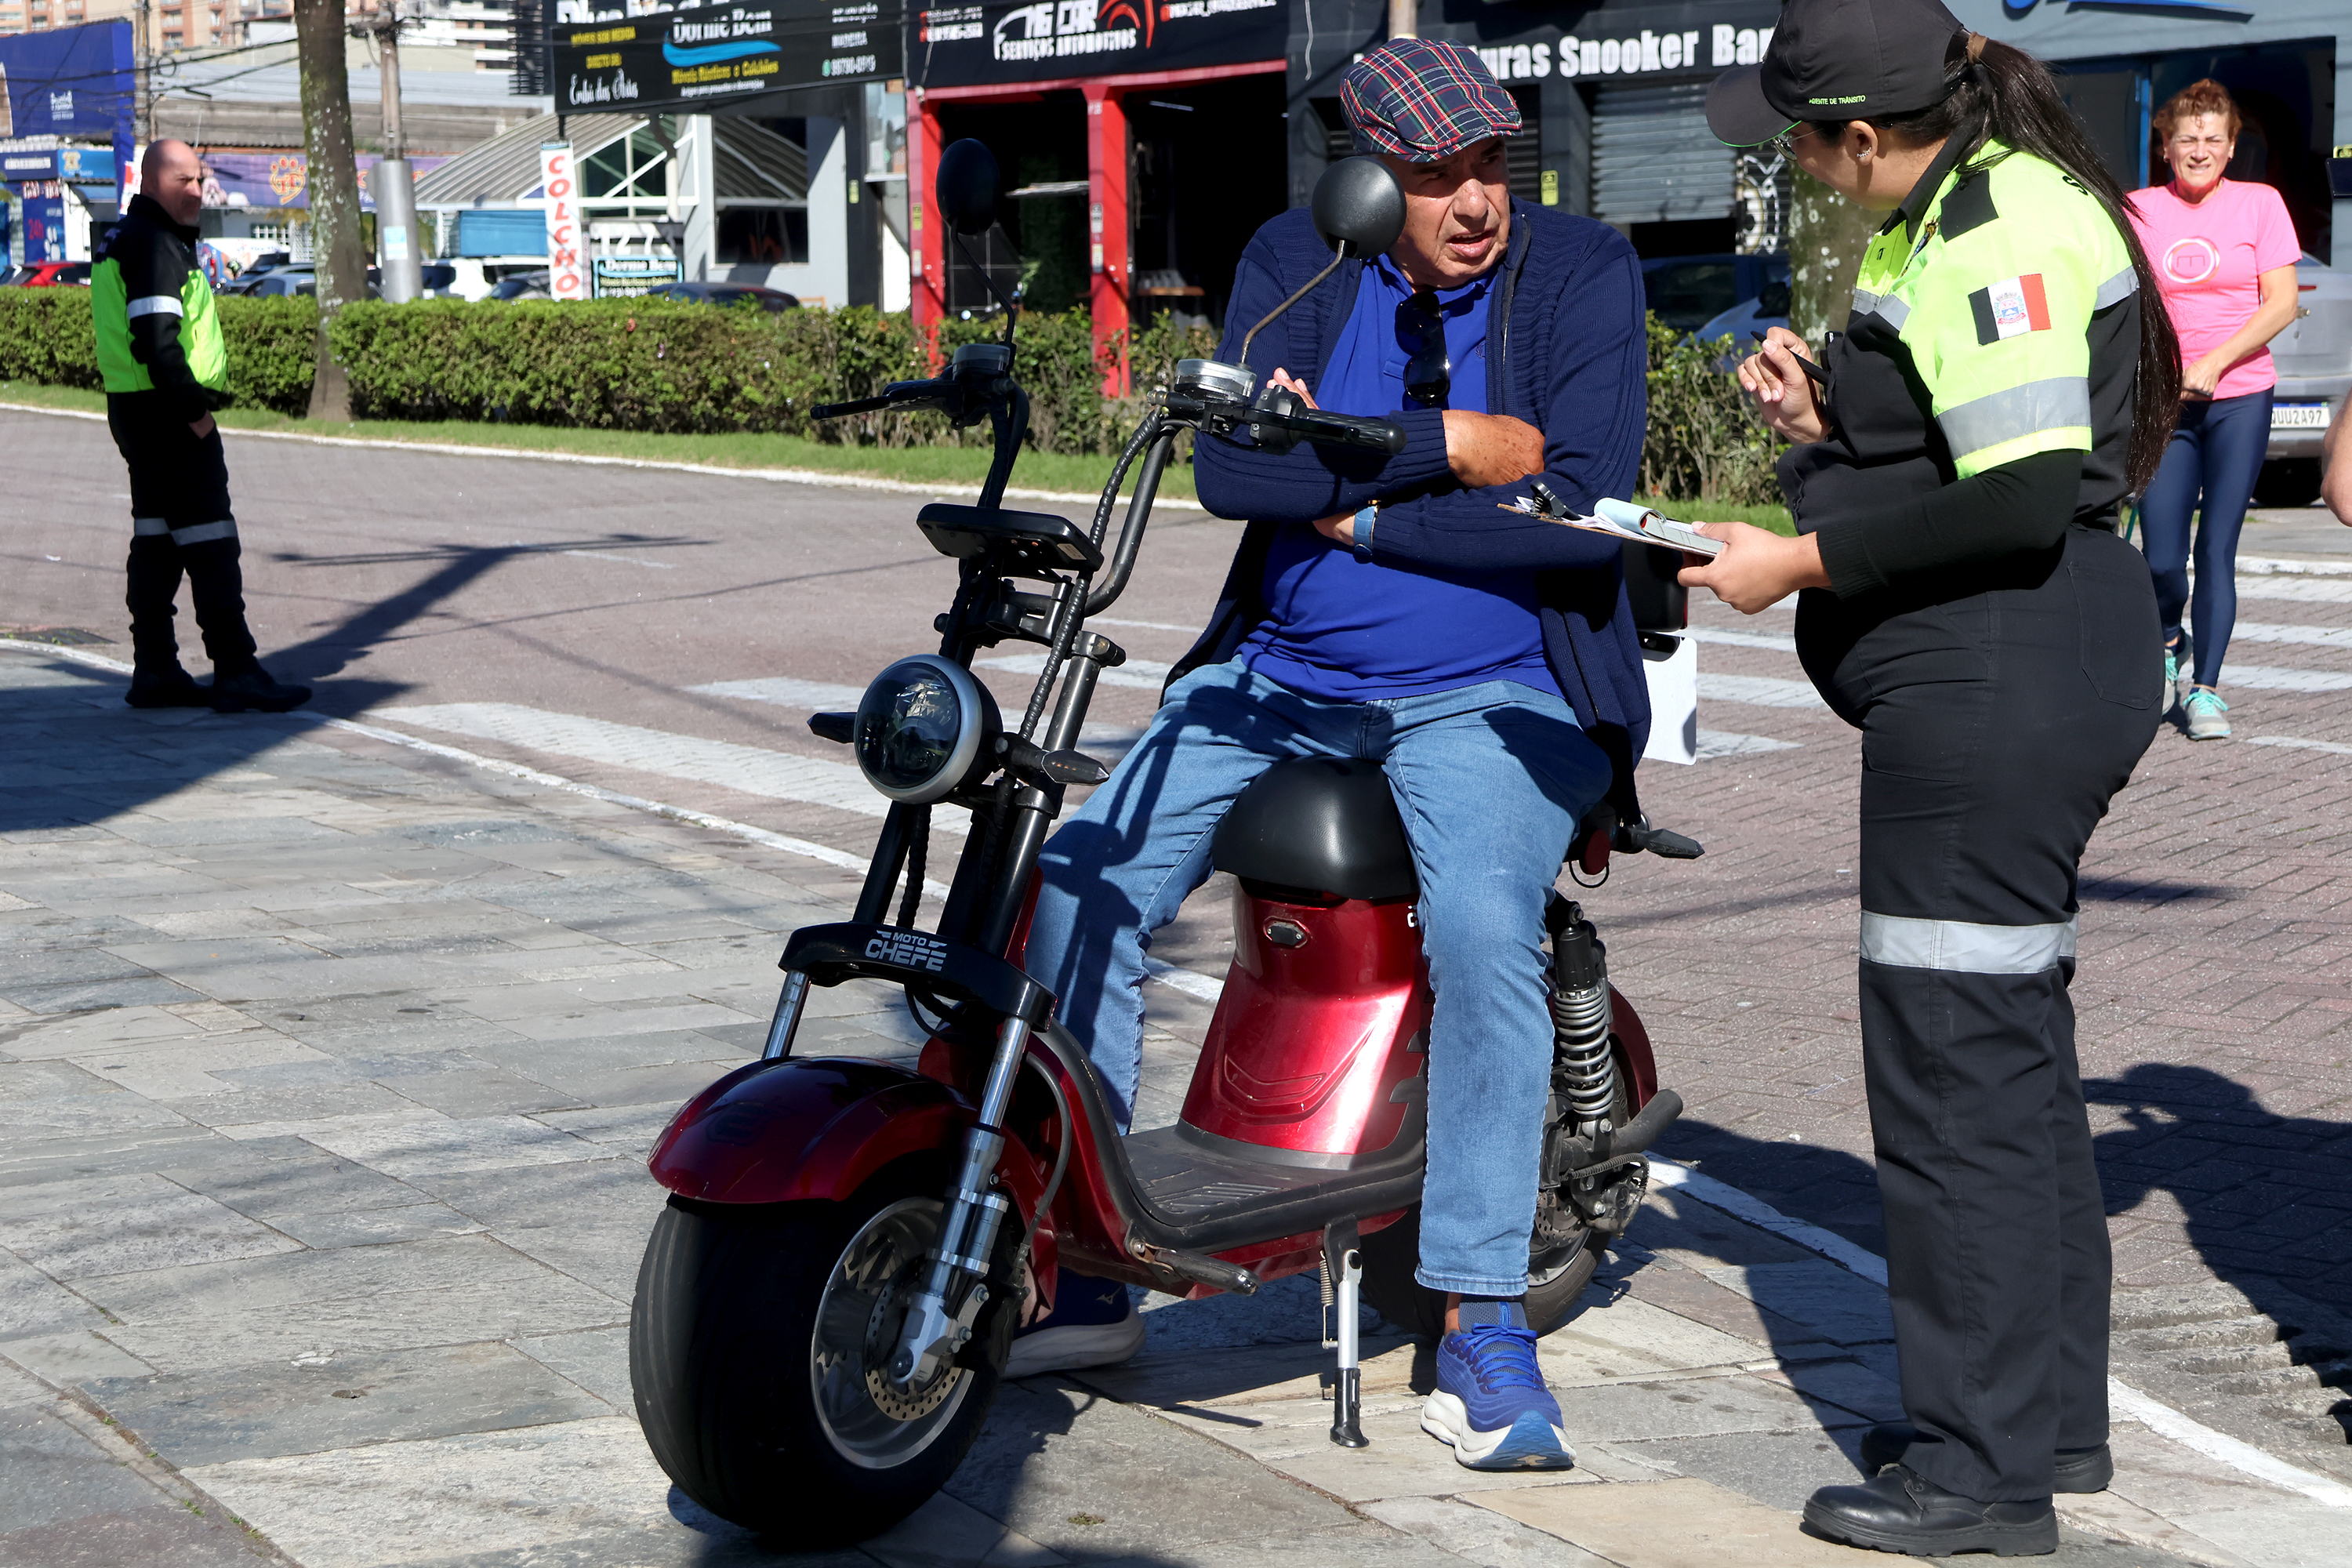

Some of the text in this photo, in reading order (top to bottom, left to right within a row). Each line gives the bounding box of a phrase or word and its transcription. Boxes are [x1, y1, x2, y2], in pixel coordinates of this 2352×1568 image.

[673, 16, 730, 43] Dorme
[731, 8, 773, 36] Bem
[1056, 0, 1098, 35] CAR
[1001, 28, 1137, 61] SERVIÇOS AUTOMOTIVOS
[1559, 30, 1699, 78] Snooker
[1712, 24, 1776, 66] Bar
[1838, 95, 1866, 104] TRÂNSITO
[548, 155, 579, 300] COLCHO
[605, 259, 677, 271] Dorme Bem
[865, 938, 947, 971] CHEFE
[892, 932, 927, 946] MOTO
